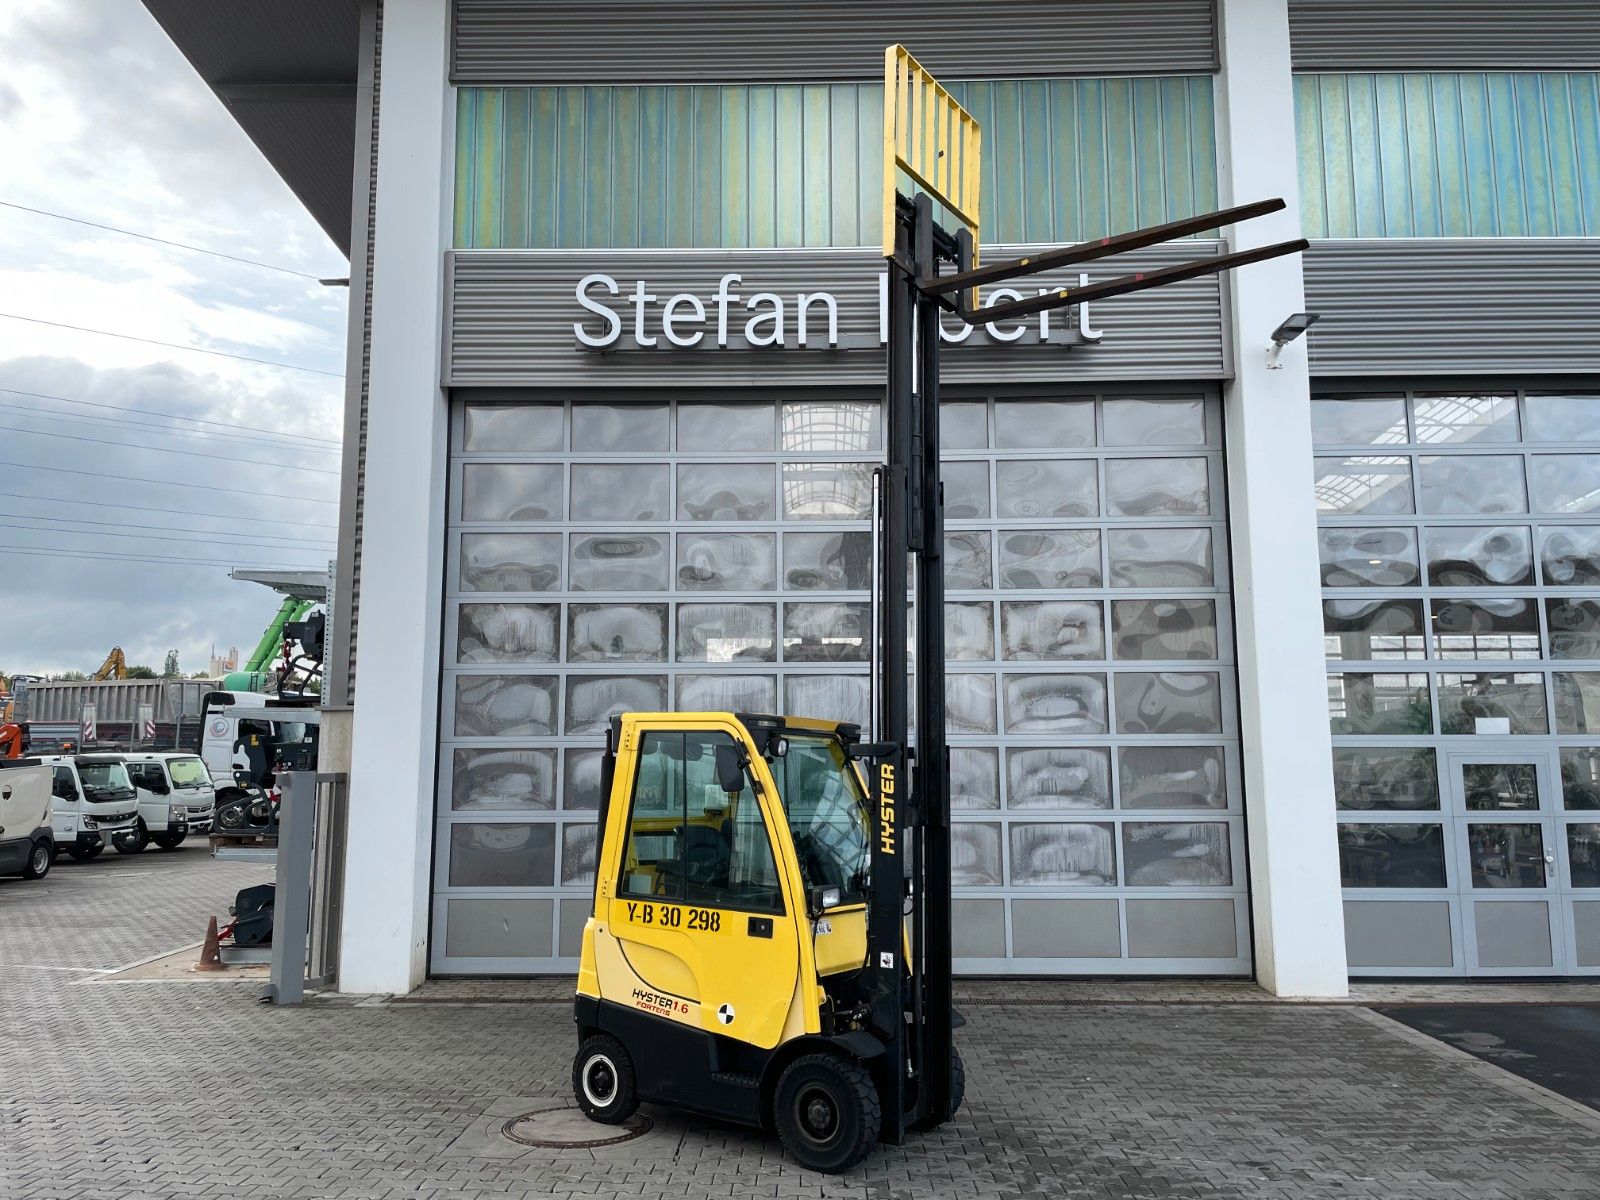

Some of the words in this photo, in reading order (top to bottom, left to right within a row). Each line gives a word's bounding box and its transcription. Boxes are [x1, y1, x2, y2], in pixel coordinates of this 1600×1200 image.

[573, 273, 838, 348] Stefan
[879, 272, 1103, 344] ert
[880, 763, 895, 855] HYSTER
[627, 902, 654, 924] Y-B
[660, 906, 681, 928] 30
[687, 908, 721, 933] 298
[632, 988, 673, 1010] HYSTER
[673, 1001, 689, 1014] 1.6
[636, 1001, 671, 1017] FORTENS
